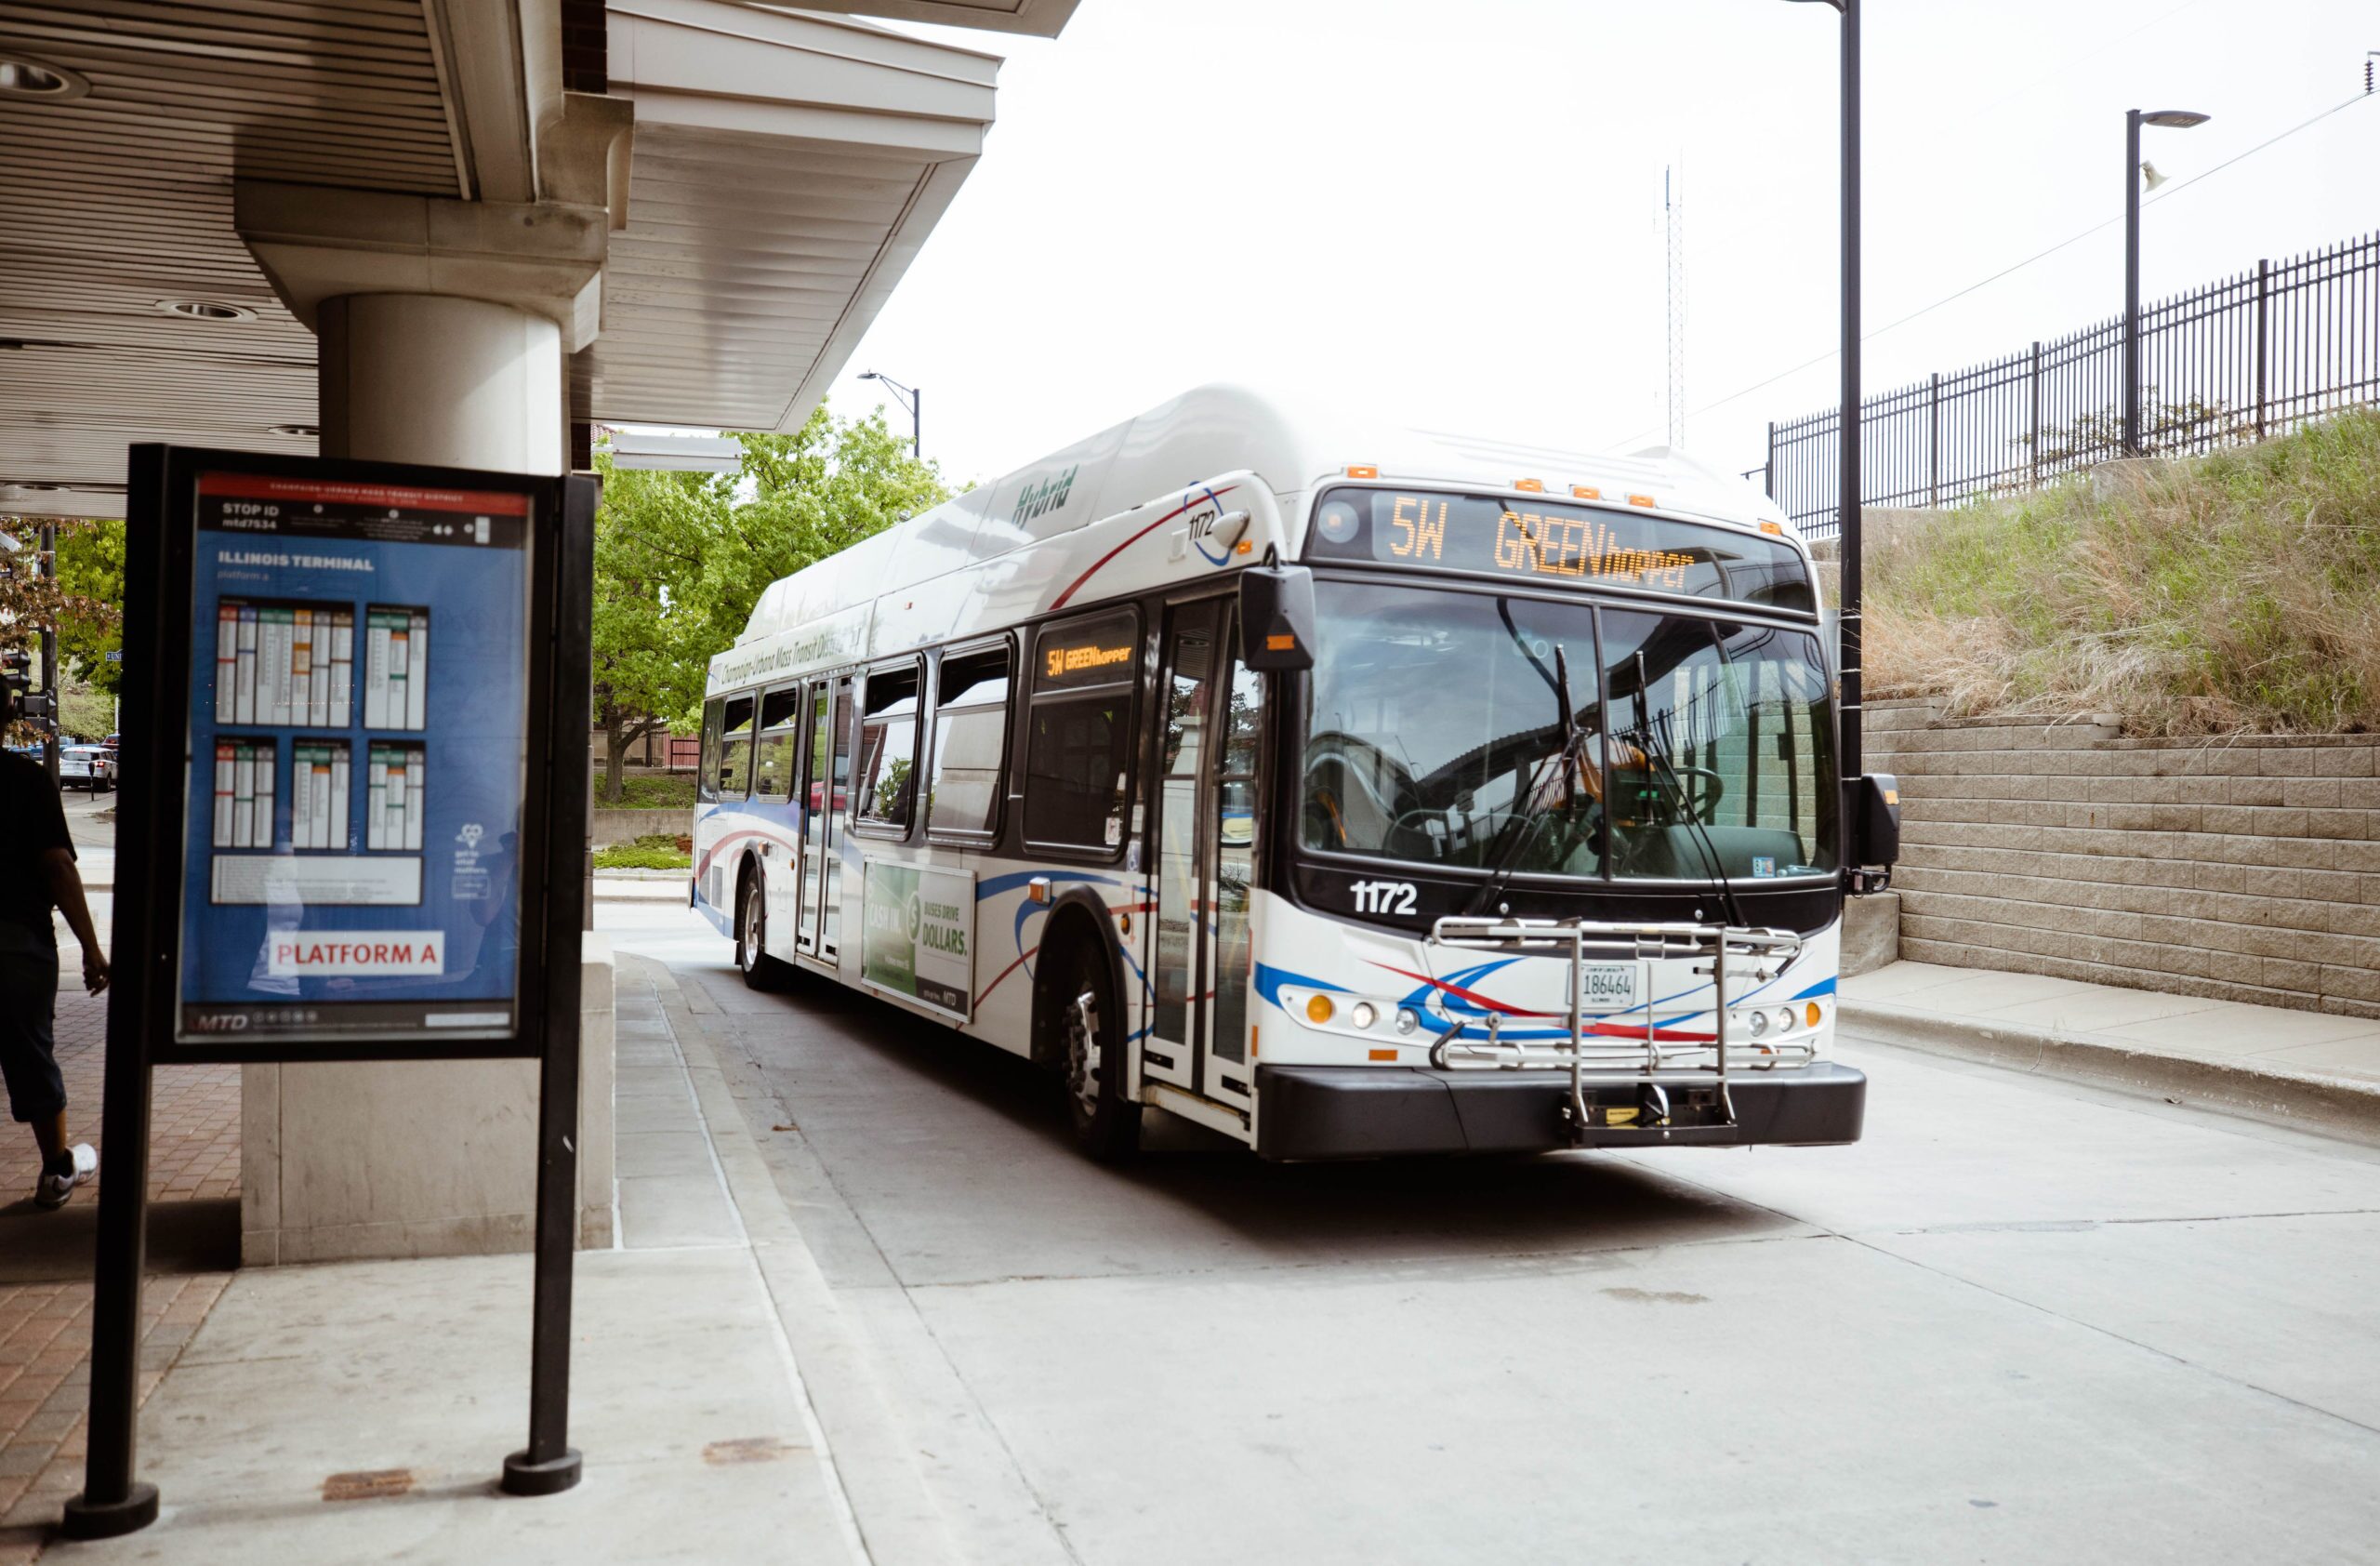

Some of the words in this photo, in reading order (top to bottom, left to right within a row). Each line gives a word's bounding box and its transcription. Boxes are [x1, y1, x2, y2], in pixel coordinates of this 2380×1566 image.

[1012, 464, 1078, 531] Hybrid
[222, 502, 261, 515] STOP
[264, 506, 280, 517] ID
[1189, 510, 1215, 540] 1172
[1391, 497, 1448, 559] 5W
[1494, 511, 1695, 588] GREENhopper
[218, 551, 289, 567] ILLINOIS
[291, 554, 375, 572] TERMINAL
[217, 570, 260, 582] platform
[721, 653, 776, 685] Champaign-Urbana
[775, 646, 792, 670] Mass
[792, 639, 818, 667] Transit
[1048, 649, 1064, 676] 5W
[1065, 646, 1131, 670] GREENhopper
[1350, 880, 1417, 915] 1172
[924, 901, 942, 918] BUSES
[943, 904, 959, 922] DRIVE
[922, 922, 968, 957] DOLLARS.
[278, 943, 412, 964] PLATFORM
[420, 943, 438, 964] A
[1583, 975, 1631, 995] 186464
[943, 990, 957, 1006] MTD
[198, 1015, 247, 1030] MTD
